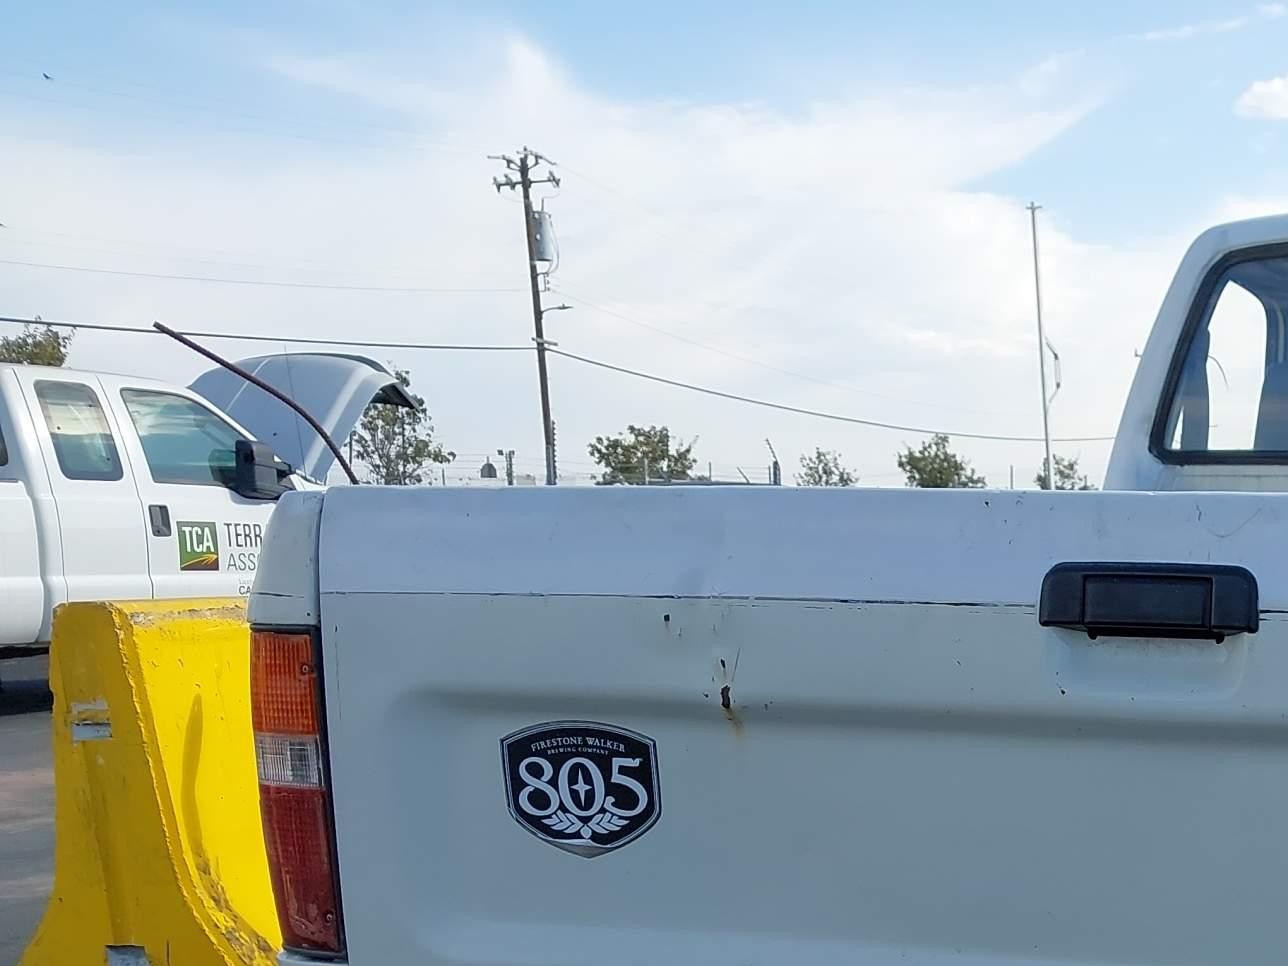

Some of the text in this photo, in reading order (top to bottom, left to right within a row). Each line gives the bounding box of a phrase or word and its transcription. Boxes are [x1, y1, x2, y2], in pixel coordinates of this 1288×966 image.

[182, 526, 215, 553] TCA
[226, 552, 260, 572] ASS
[530, 736, 626, 753] FIRESTONE WALKER
[547, 747, 609, 756] BREWING COMPANY
[518, 756, 649, 817] 805
